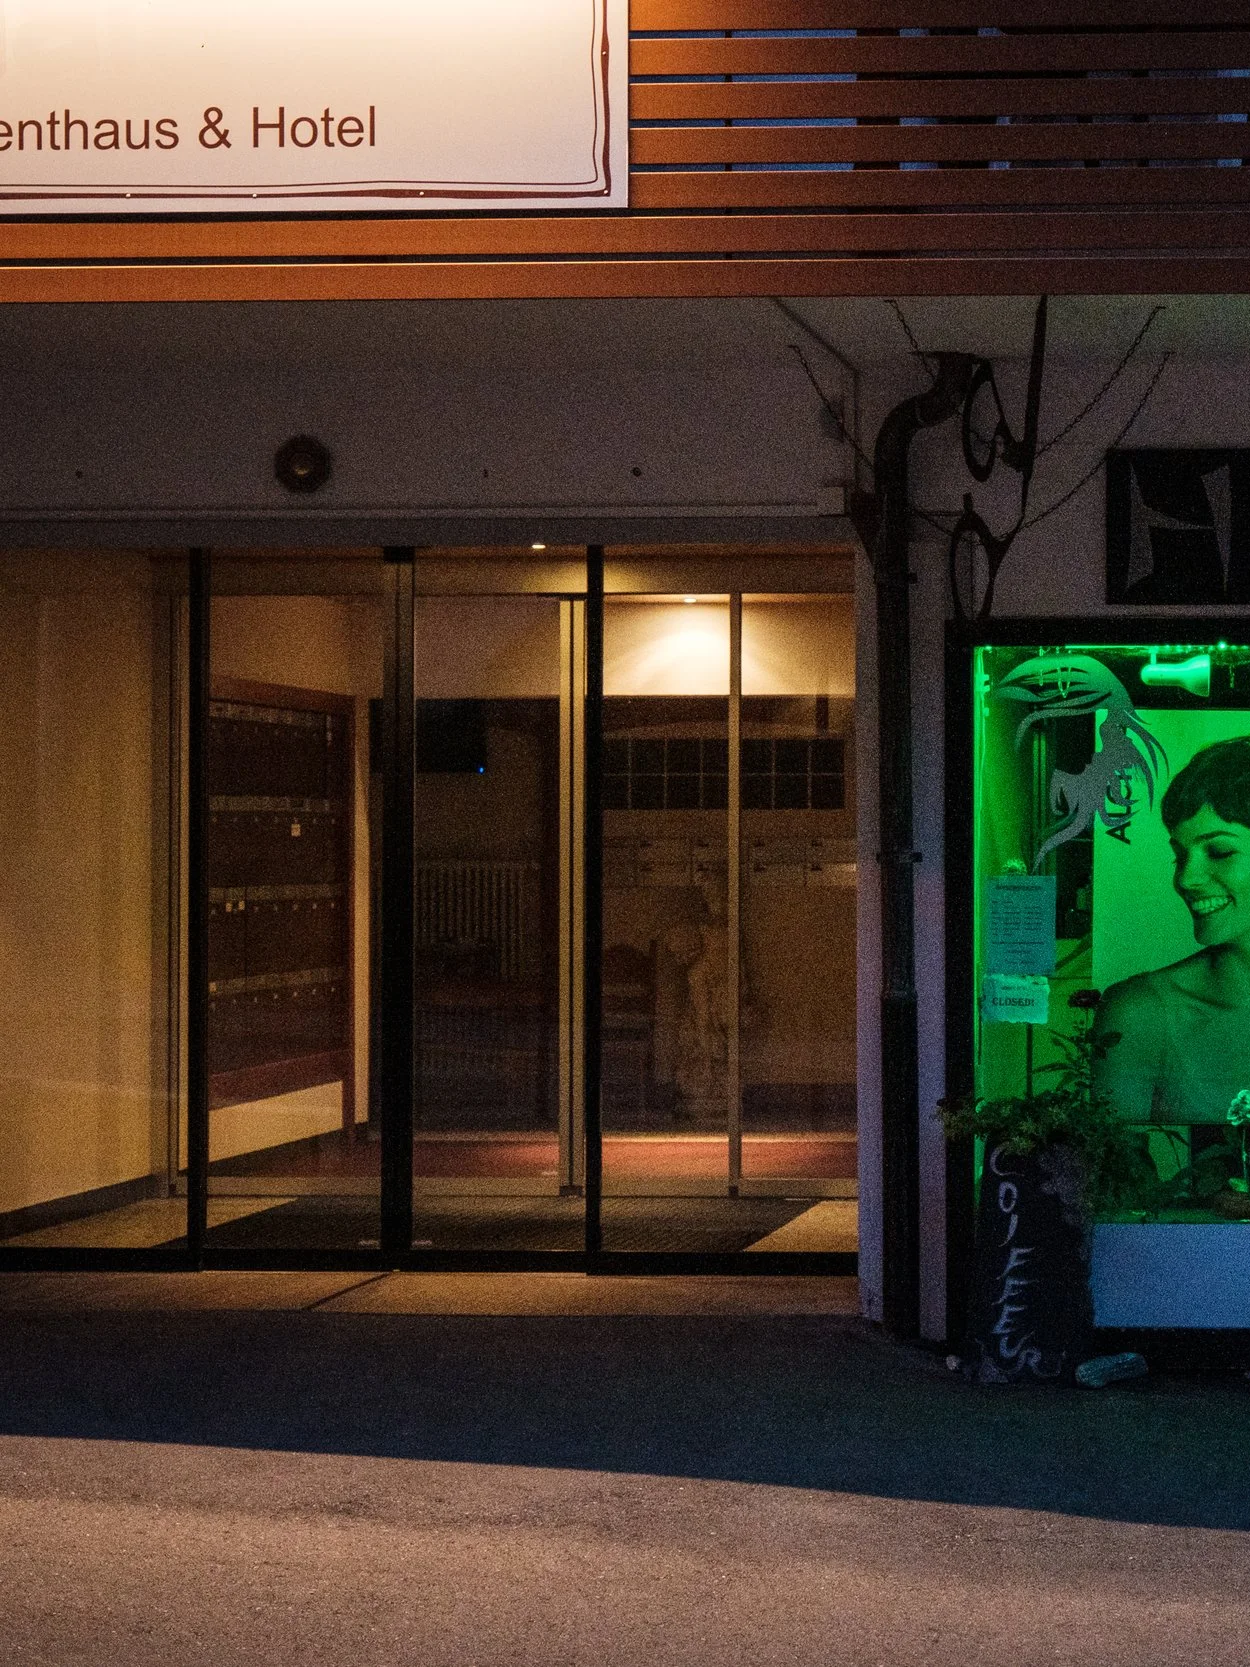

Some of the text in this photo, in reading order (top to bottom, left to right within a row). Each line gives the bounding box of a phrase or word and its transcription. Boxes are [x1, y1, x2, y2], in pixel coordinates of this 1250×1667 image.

[0, 106, 376, 151] enthaus & Hotel
